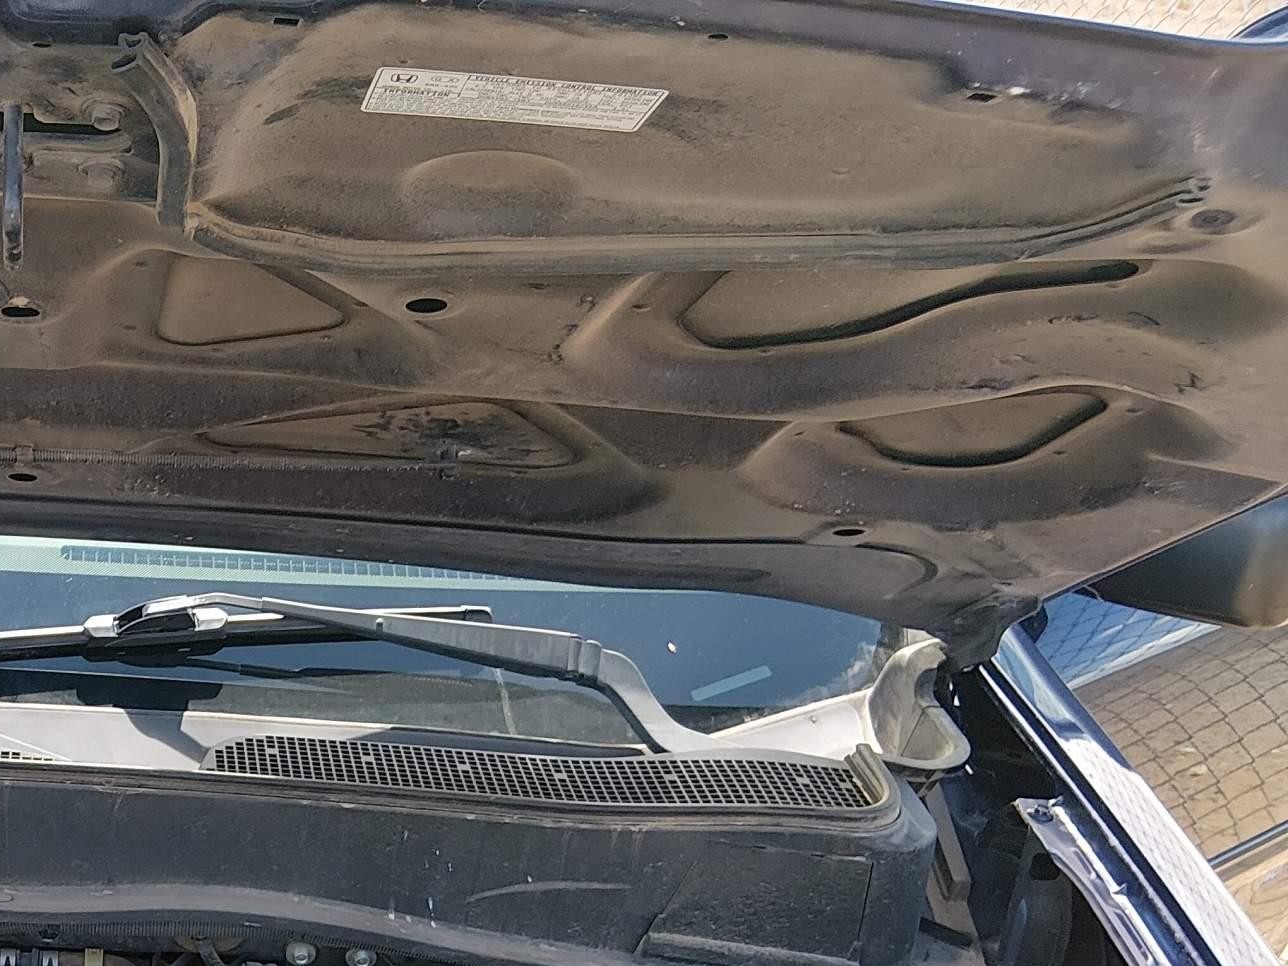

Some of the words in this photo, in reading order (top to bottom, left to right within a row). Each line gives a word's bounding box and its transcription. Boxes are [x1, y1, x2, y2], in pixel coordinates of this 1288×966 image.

[475, 75, 510, 83] VEHICLE
[515, 79, 556, 88] EMISSION
[561, 82, 595, 91] CONTROL
[602, 86, 660, 97] INFORMATION
